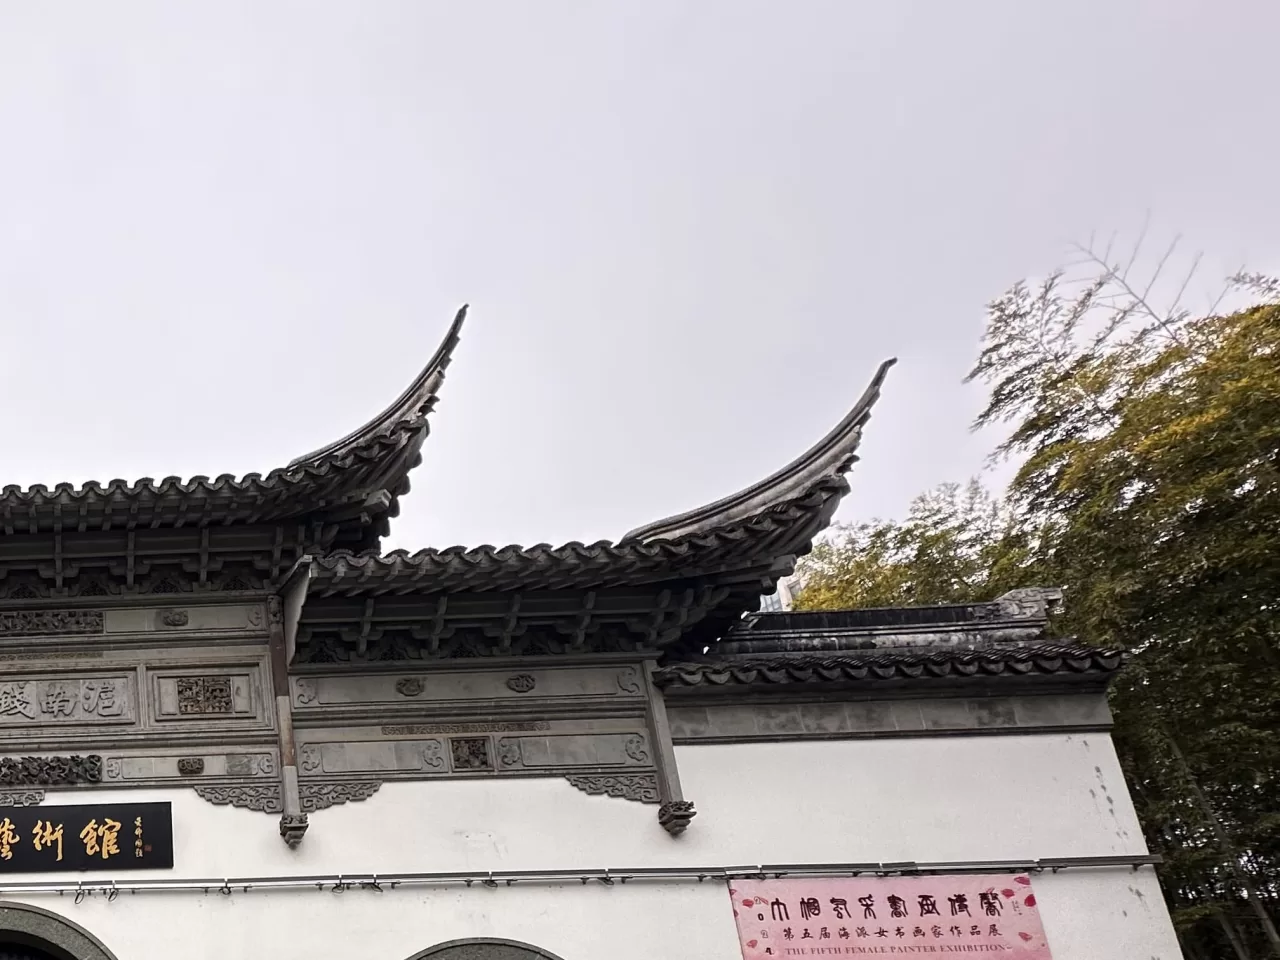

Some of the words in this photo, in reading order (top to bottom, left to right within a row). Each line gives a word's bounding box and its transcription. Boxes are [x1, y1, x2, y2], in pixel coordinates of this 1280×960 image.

[783, 924, 1003, 941] 第五届海派女书画家作品展
[811, 947, 841, 955] FIFTH
[845, 946, 887, 954] FEMALE
[890, 945, 936, 953] PAINTER
[940, 944, 1005, 953] EXHIBITION
